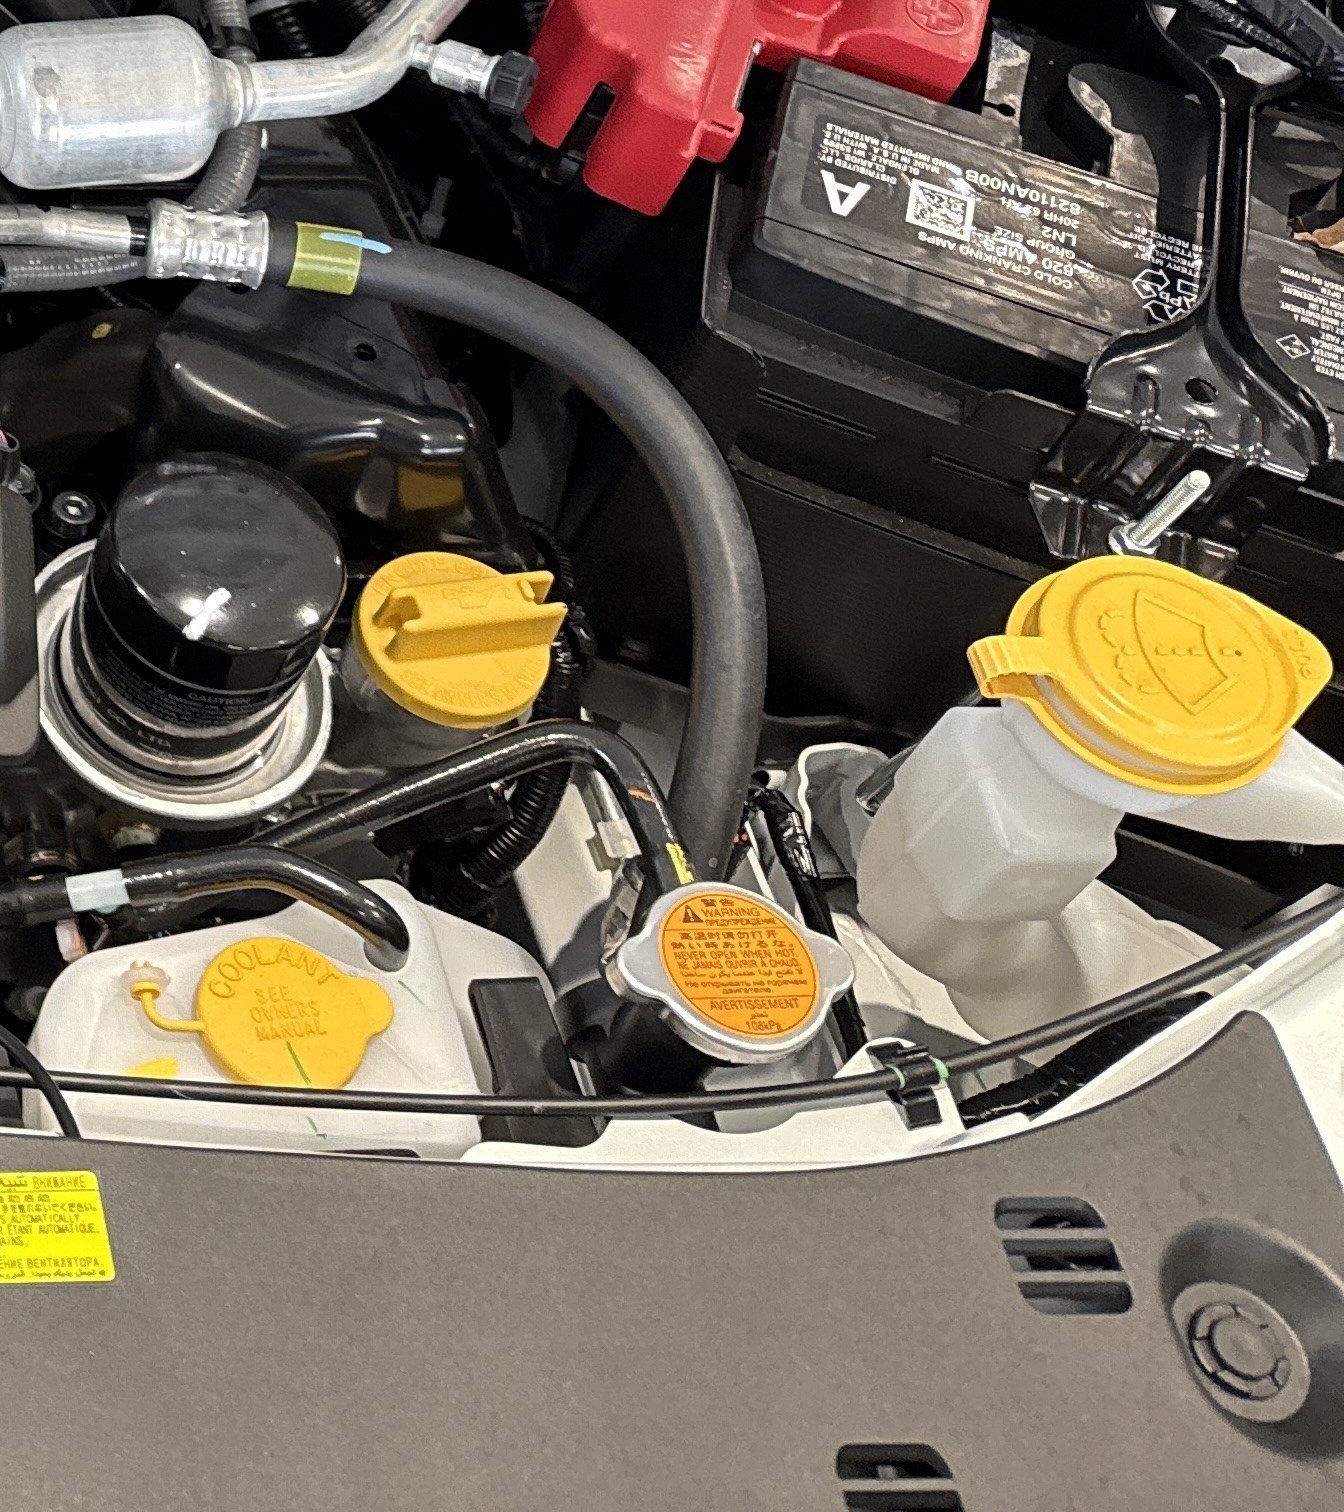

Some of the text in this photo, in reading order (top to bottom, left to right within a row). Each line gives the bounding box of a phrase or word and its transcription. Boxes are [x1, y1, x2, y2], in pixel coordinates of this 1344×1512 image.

[820, 169, 871, 217] A
[965, 169, 1081, 216] 82110AN00B
[1043, 209, 1080, 229] 20HR
[994, 226, 1076, 260] GROUP SIZE
[1041, 225, 1078, 247] LN2
[917, 231, 1073, 290] COLD CRANKING AMPS
[1041, 257, 1074, 277] 620
[1158, 290, 1183, 307] Pb
[188, 692, 251, 705] CAUTION
[701, 907, 760, 918] WARNING
[674, 950, 706, 960] NEVER
[710, 950, 738, 960] OPEN
[741, 949, 773, 959] WHEN
[692, 960, 723, 969] JAMAIS
[724, 959, 759, 969] OUVRIR
[208, 942, 340, 1000] COOLANT
[253, 984, 293, 1004] SEE
[710, 998, 800, 1011] AVERTISSEMENT
[253, 1020, 329, 1042] MANUAL
